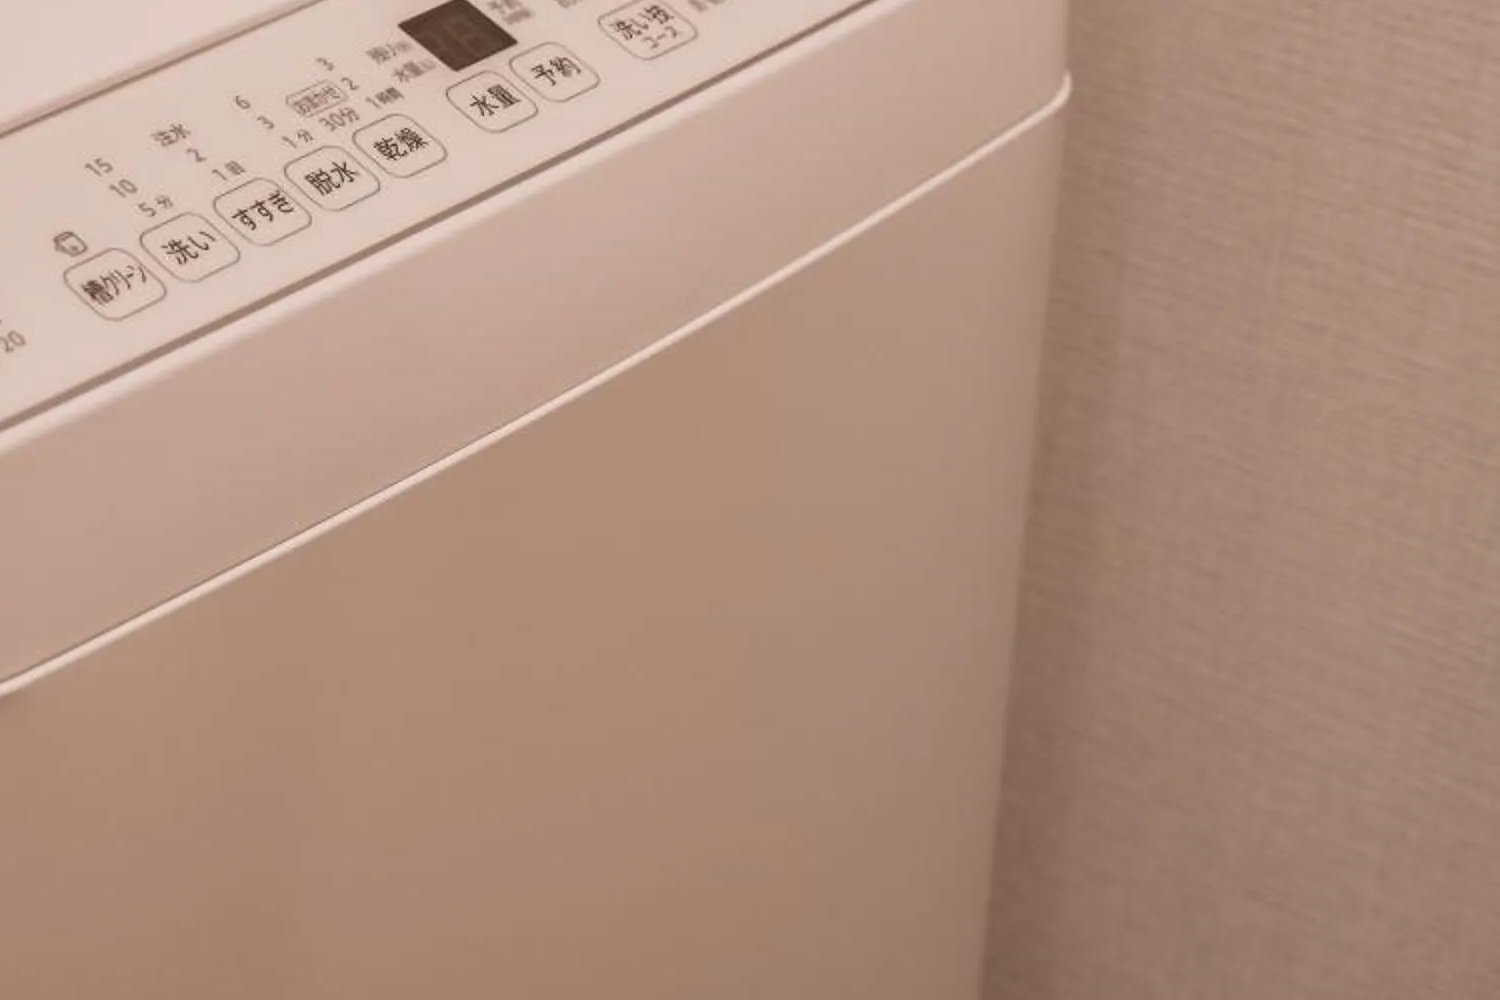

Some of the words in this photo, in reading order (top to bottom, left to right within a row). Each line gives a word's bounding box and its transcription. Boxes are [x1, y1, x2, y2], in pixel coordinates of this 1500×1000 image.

[340, 76, 361, 92] 2
[234, 94, 252, 110] 6
[470, 83, 521, 118] 水量
[257, 114, 276, 130] 3
[373, 127, 429, 162] 乾燥
[187, 148, 207, 163] 2
[85, 158, 113, 177] 15
[304, 160, 361, 196] 脱水
[109, 178, 138, 199] 10
[232, 190, 295, 231] すすぎ
[160, 231, 217, 266] 洗い
